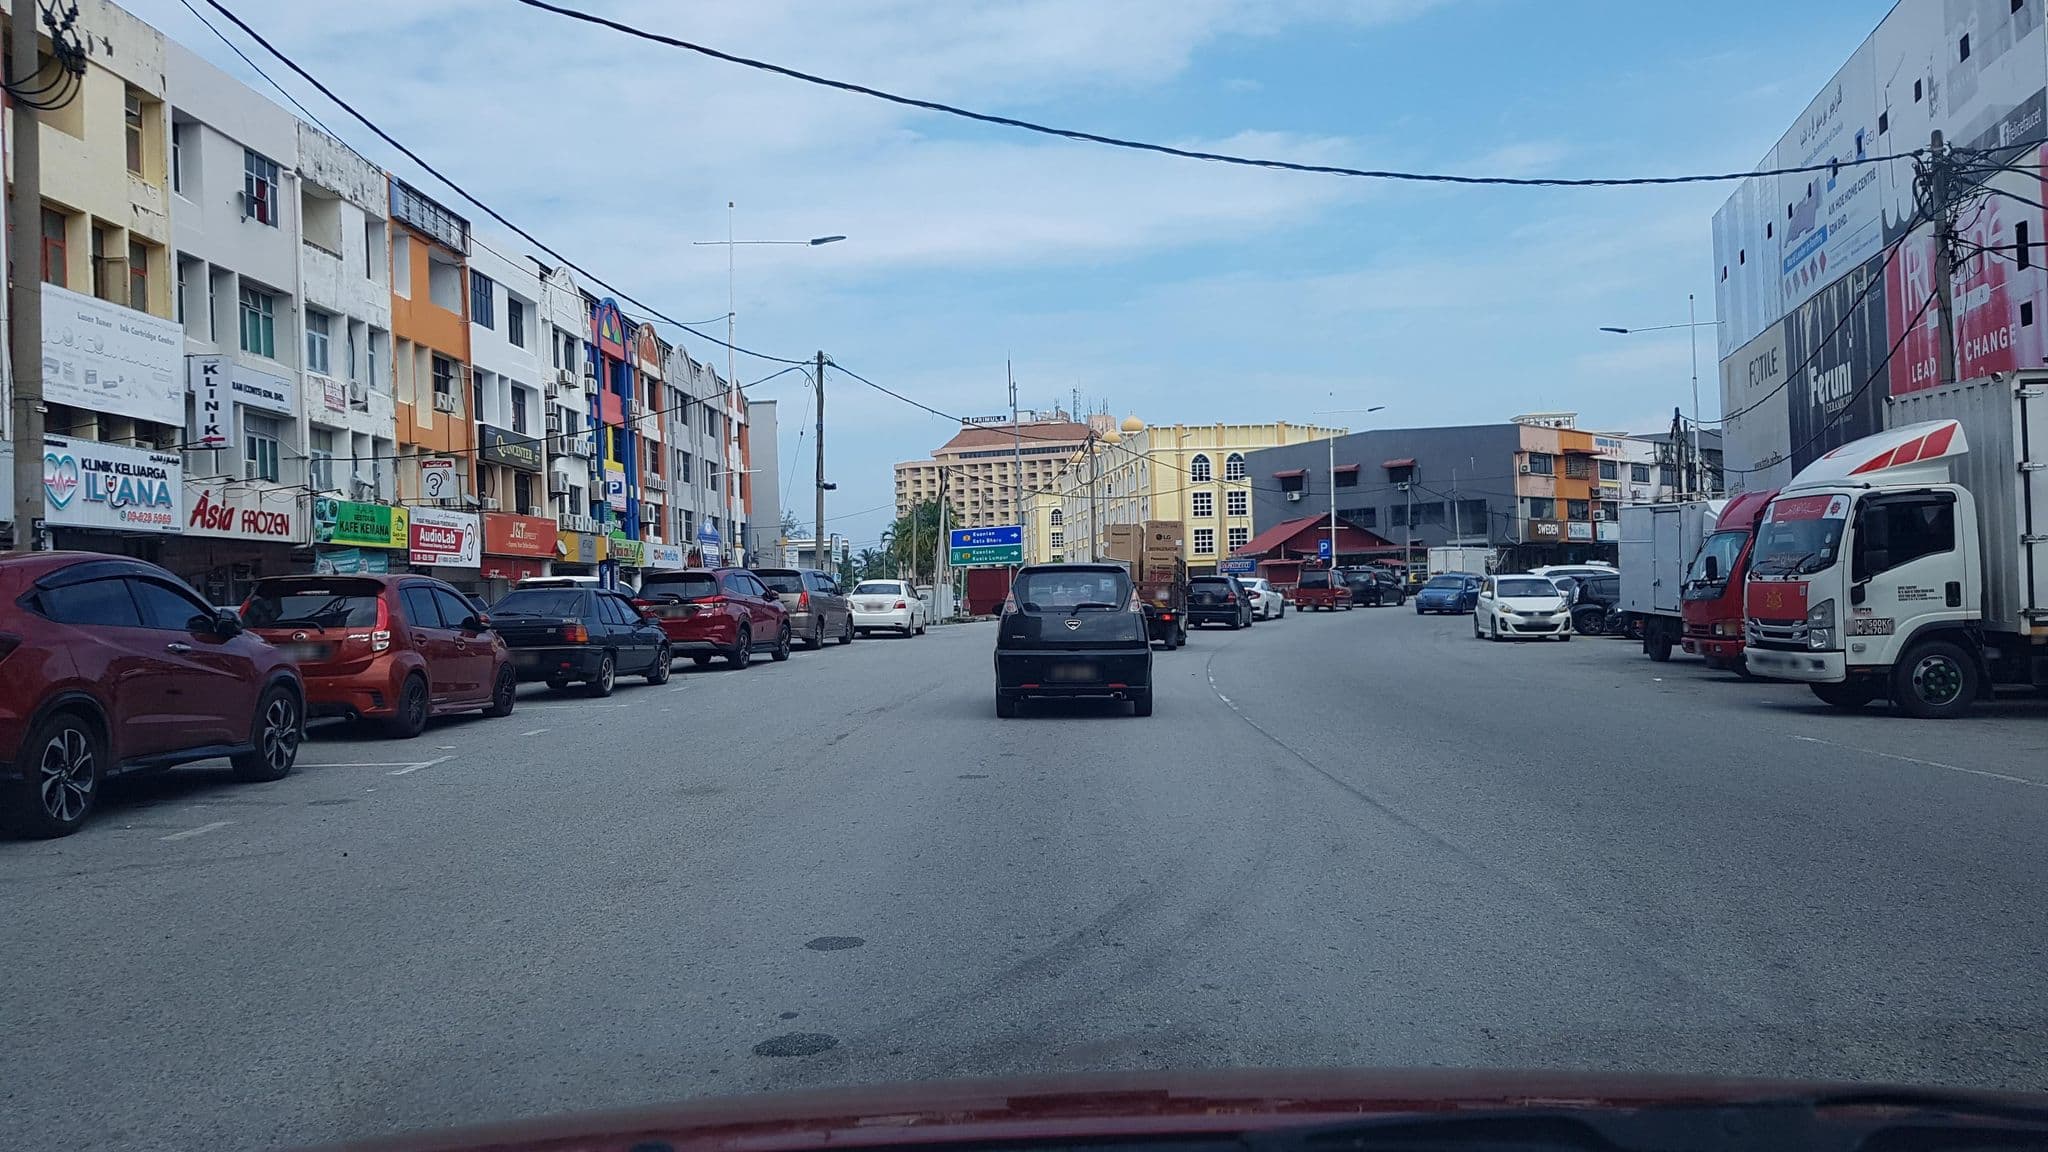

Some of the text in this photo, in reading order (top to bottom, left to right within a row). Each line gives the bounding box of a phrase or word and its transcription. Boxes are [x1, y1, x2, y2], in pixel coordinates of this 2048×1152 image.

[1858, 167, 1877, 191] CENTRE
[77, 311, 94, 324] Laser
[96, 316, 113, 329] Toner
[120, 323, 130, 334] Ink
[130, 328, 157, 342] Cartridge
[1965, 323, 2017, 363] CHANGE
[1749, 346, 1778, 388] FOTILE
[1911, 357, 1937, 383] LEAD
[1810, 360, 1852, 407] Feruni
[203, 364, 219, 435] KLINIK
[973, 415, 1006, 423] PRIMULA
[81, 457, 168, 480] KLINIK KELUARGA
[609, 482, 619, 494] P
[189, 489, 290, 536] Asia FROZEN
[339, 520, 359, 534] KAFE
[360, 523, 390, 536] KEMANA
[419, 527, 456, 545] AudioLab
[1537, 524, 1559, 535] SWEDEN
[989, 554, 1009, 562] Lumpur
[1319, 540, 1329, 553] P
